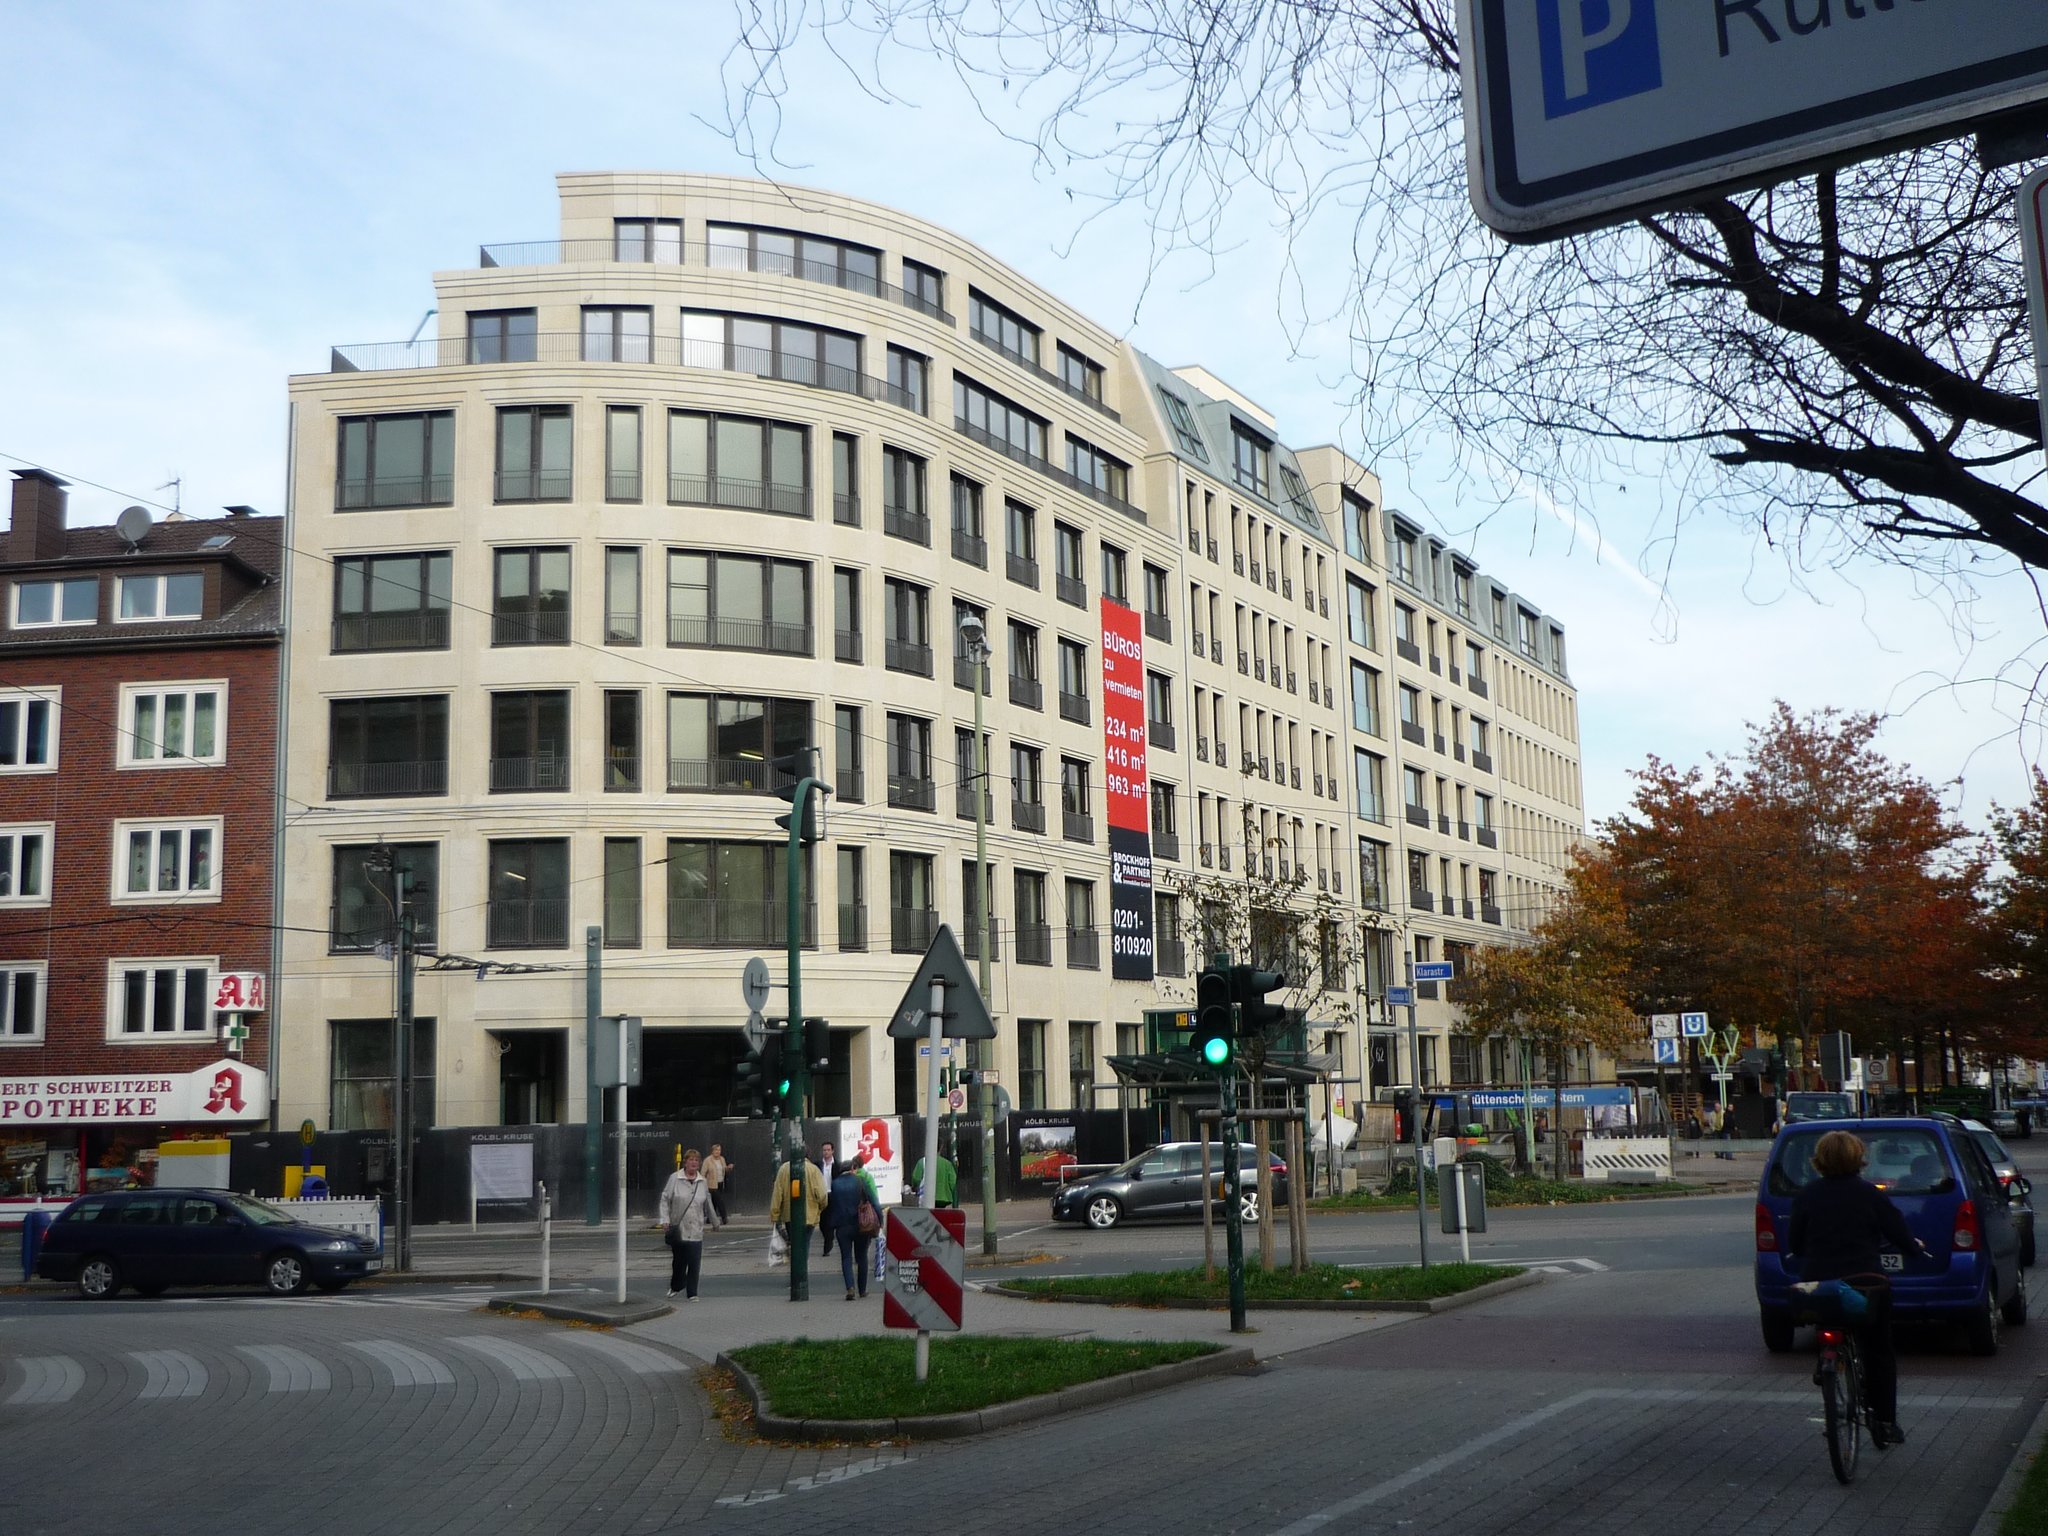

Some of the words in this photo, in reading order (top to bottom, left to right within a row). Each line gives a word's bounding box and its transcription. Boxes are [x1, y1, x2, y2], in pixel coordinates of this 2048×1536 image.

[1103, 631, 1141, 660] BÜROS
[1104, 658, 1114, 671] zu
[1105, 678, 1143, 701] vermieten
[1106, 716, 1127, 739] 234
[1107, 745, 1128, 767] 416
[1108, 773, 1129, 796] 963
[1113, 851, 1151, 867] BROCKHOFF
[1113, 862, 1123, 883] &
[1122, 864, 1151, 878] PARTNER
[1113, 908, 1144, 930] 0201-
[1114, 934, 1152, 956] 810920
[47, 1080, 173, 1095] SCHWEITZER
[1472, 1093, 1549, 1105] üttenscheder
[1560, 1093, 1585, 1104] tern
